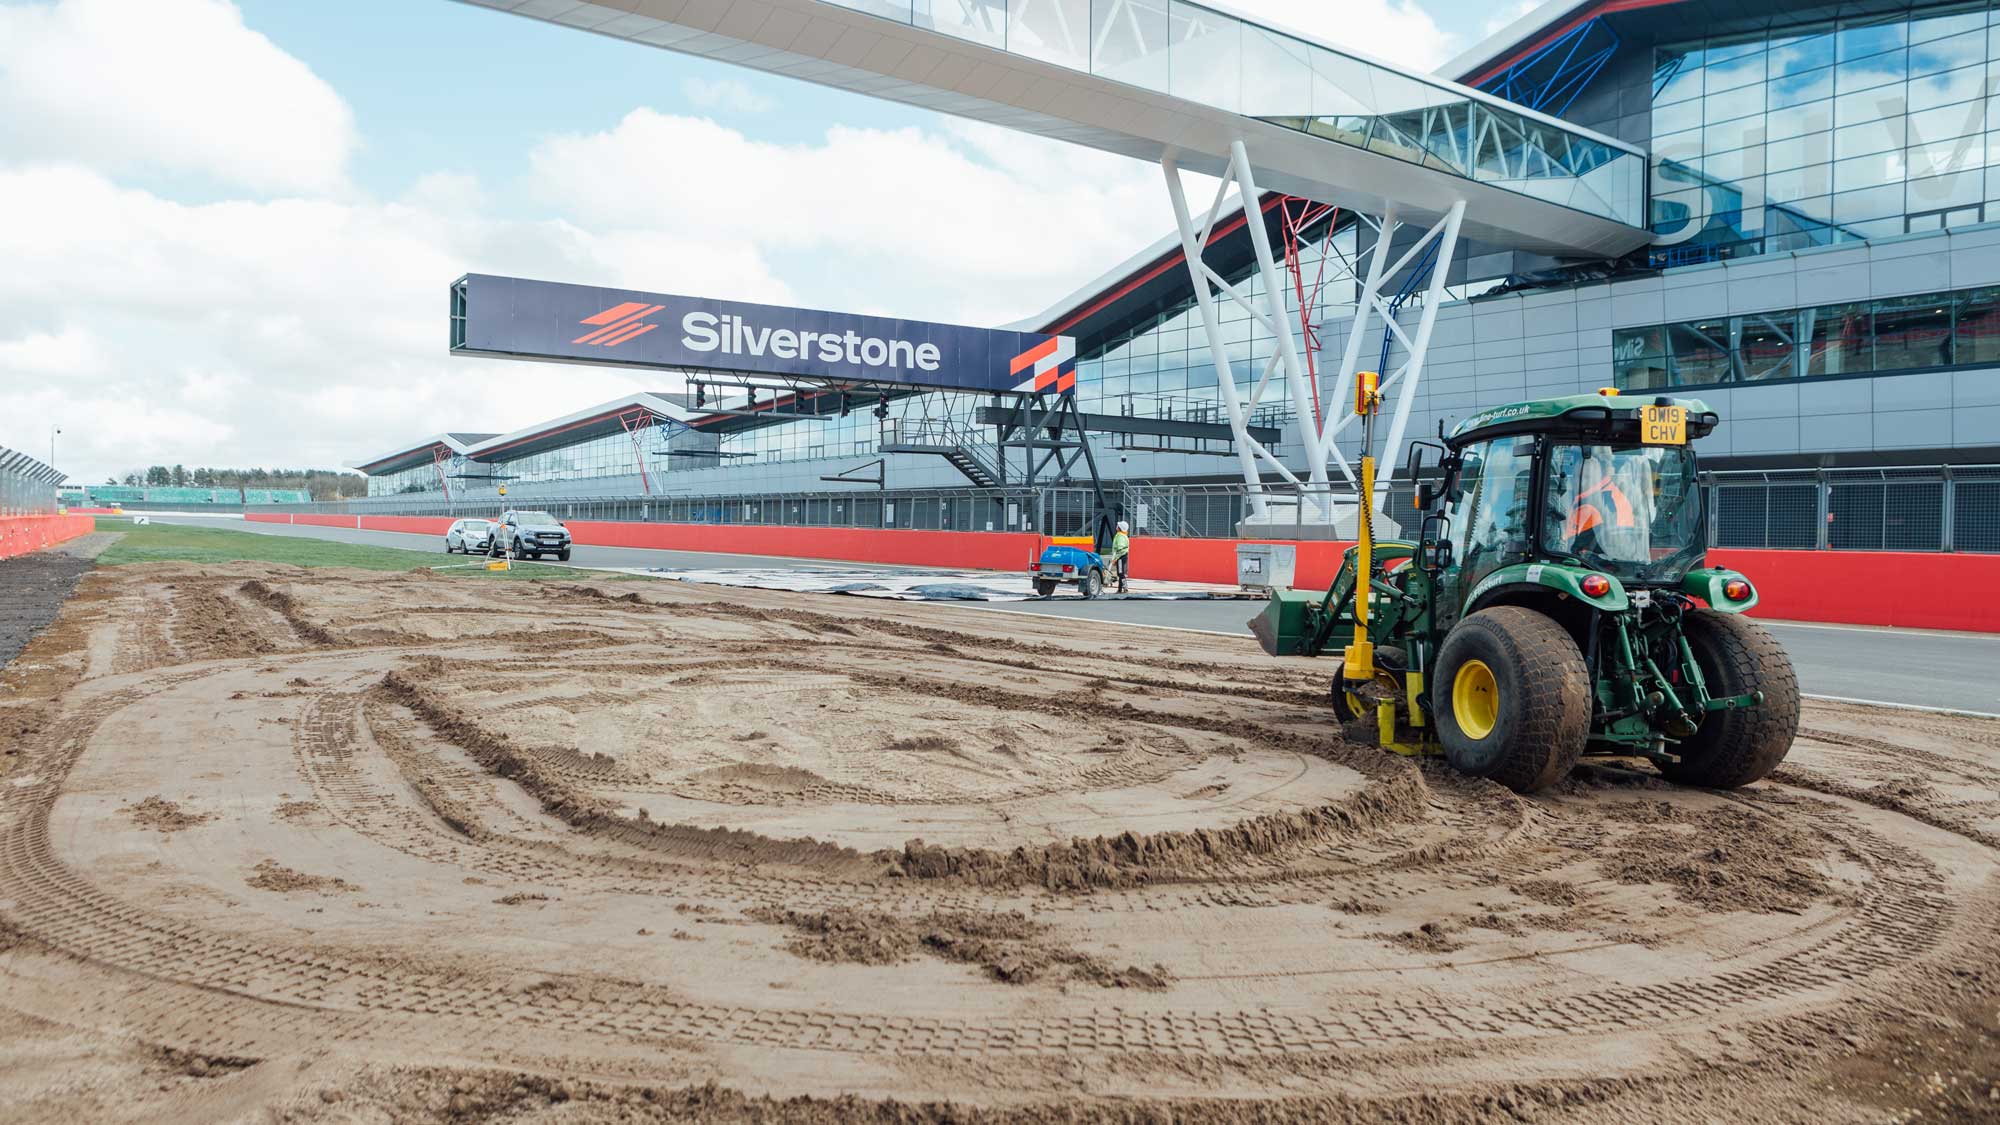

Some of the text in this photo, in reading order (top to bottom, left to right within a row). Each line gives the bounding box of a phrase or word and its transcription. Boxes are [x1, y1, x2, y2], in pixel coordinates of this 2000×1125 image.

[681, 311, 941, 371] Silverstone
[1648, 407, 1679, 423] OW19
[1650, 425, 1677, 440] CHV
